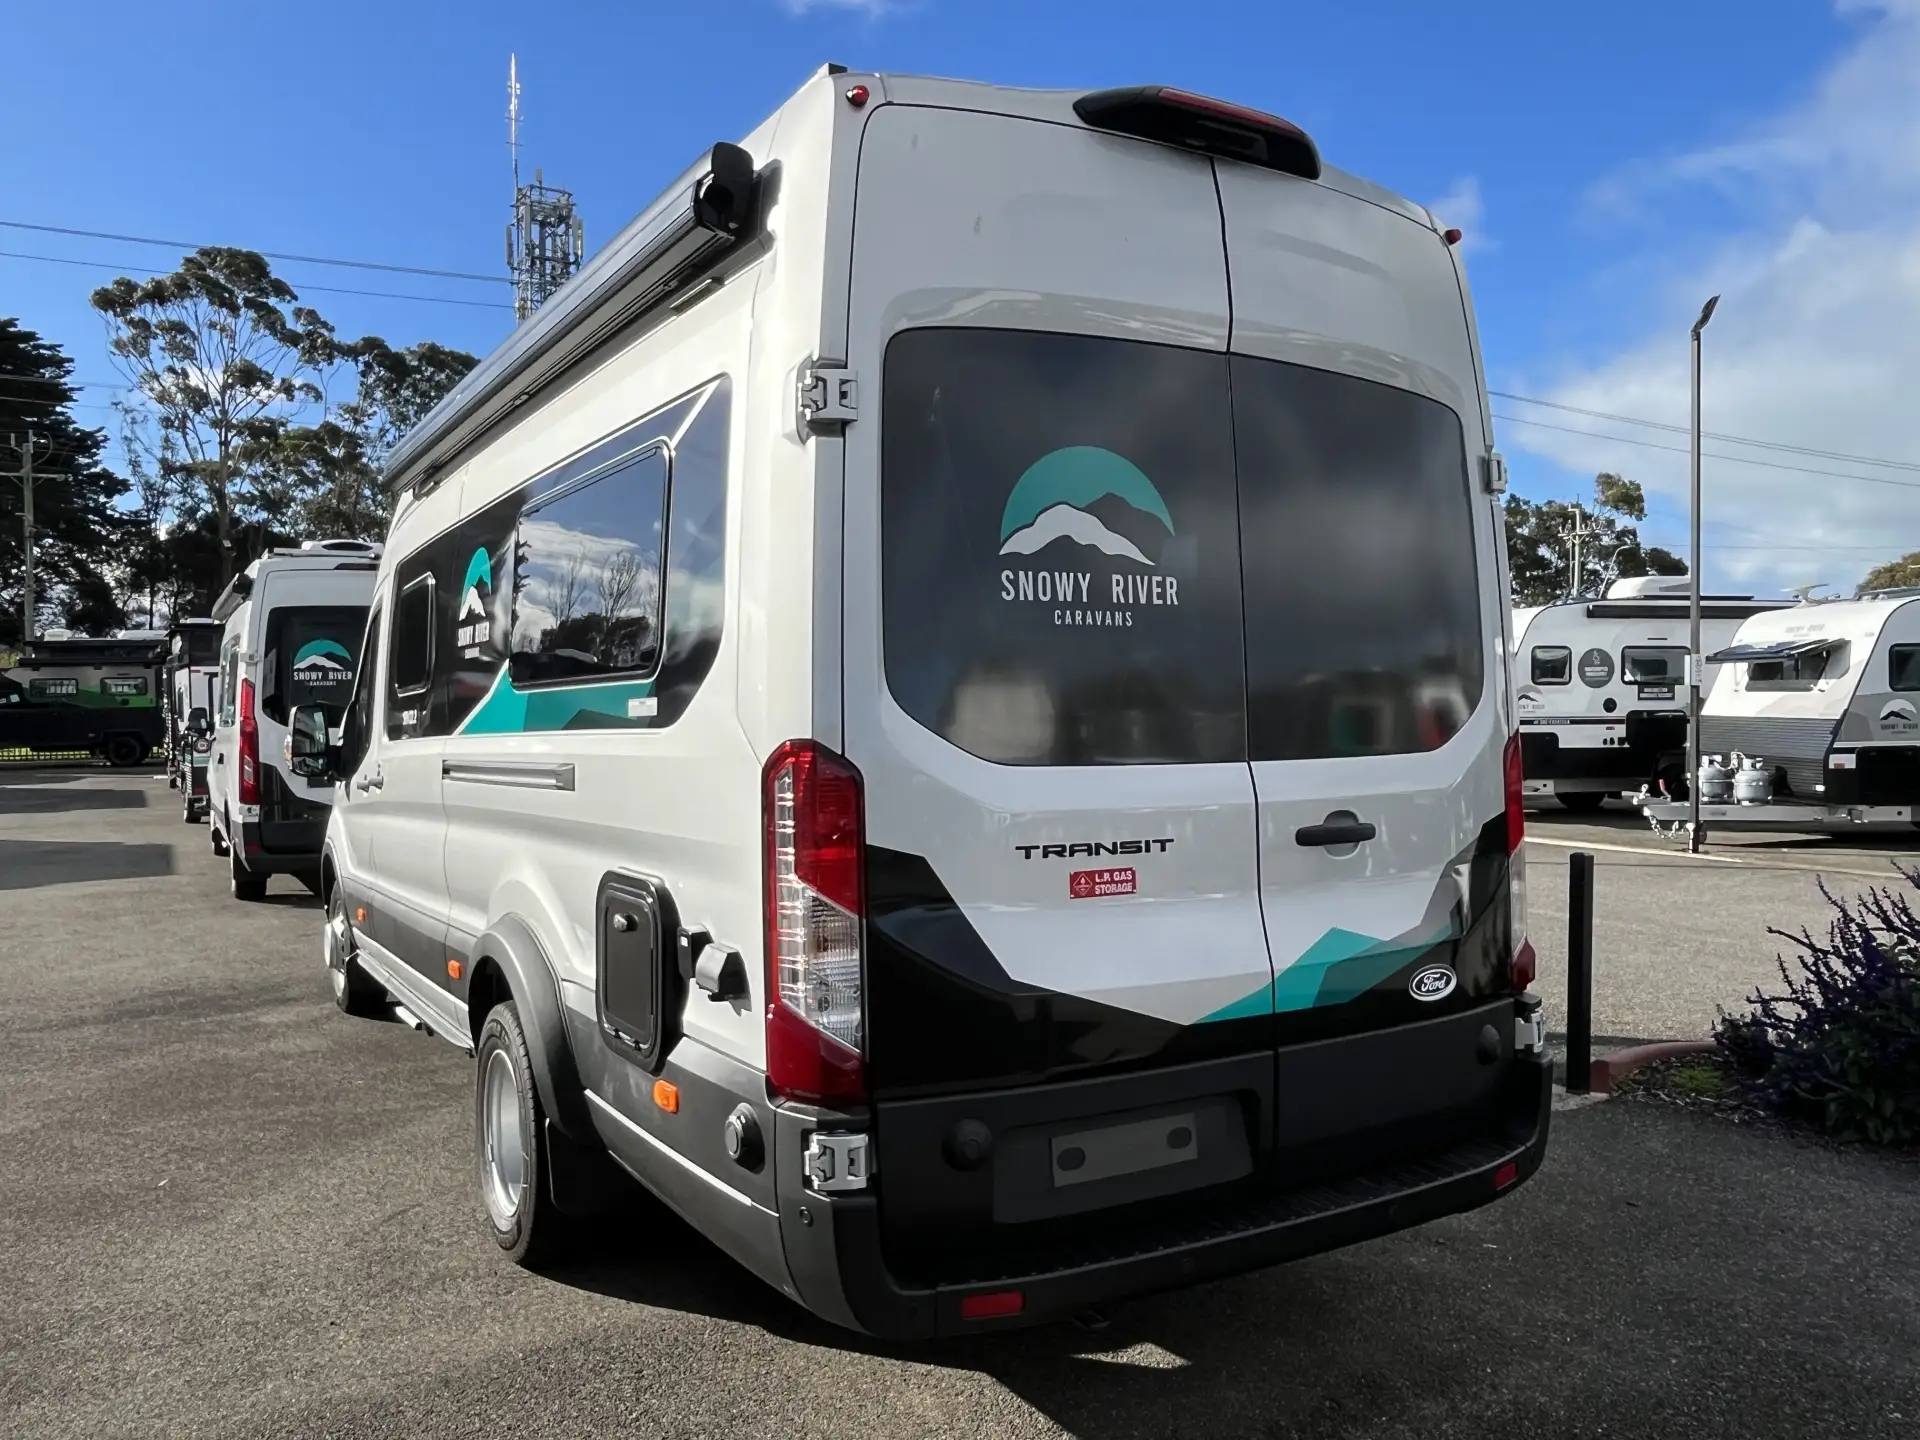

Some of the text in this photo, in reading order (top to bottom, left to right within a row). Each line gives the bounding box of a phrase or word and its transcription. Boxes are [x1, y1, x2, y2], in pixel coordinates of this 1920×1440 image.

[1001, 569, 1178, 605] SNOWY RIVER
[1054, 609, 1133, 626] CARAVANS
[294, 671, 352, 681] SNOWY RIVER
[1015, 838, 1174, 860] TRANSIT
[1113, 870, 1132, 881] GAS
[1095, 882, 1132, 894] STORAGE
[1421, 973, 1447, 992] Ford
